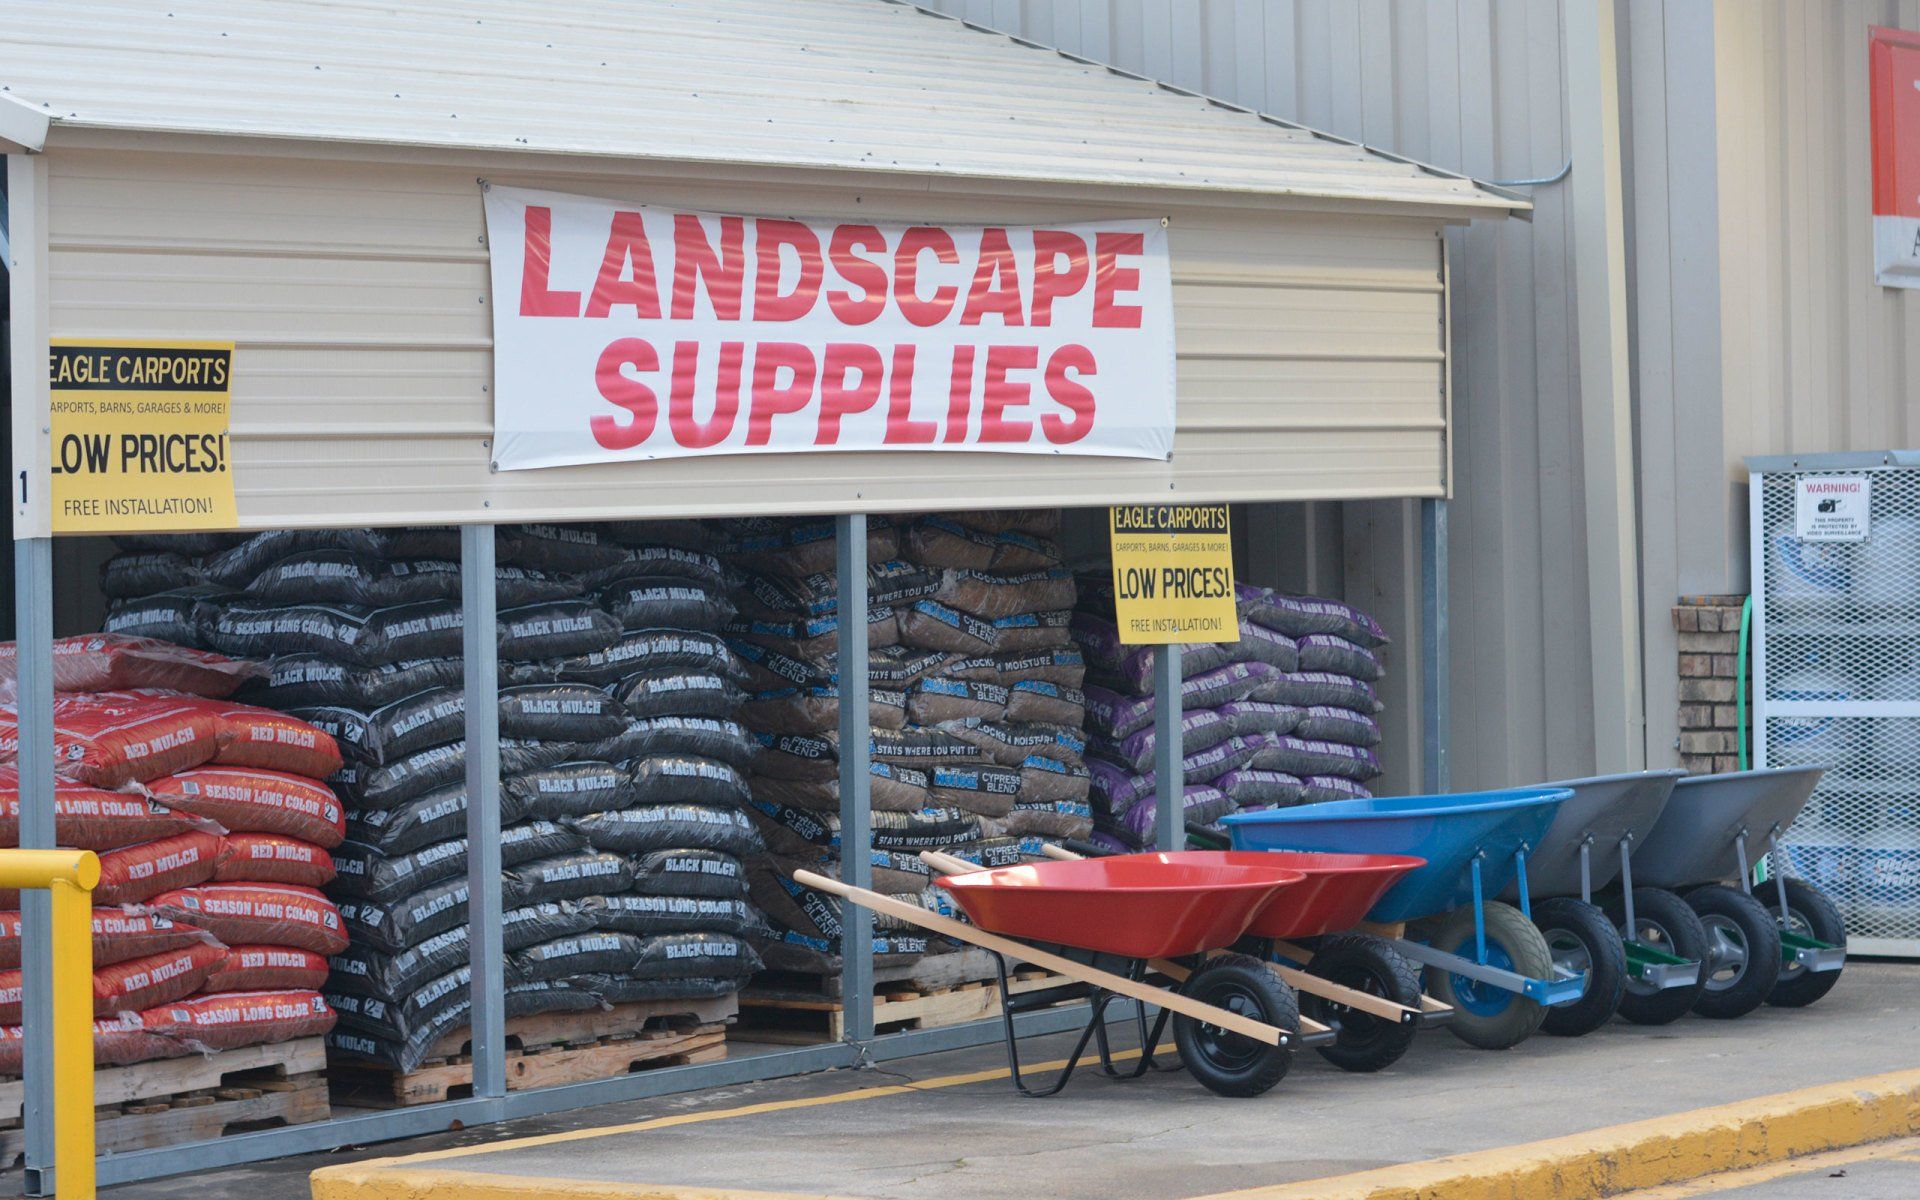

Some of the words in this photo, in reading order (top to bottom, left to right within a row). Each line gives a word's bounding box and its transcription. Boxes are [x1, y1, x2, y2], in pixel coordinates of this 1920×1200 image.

[519, 206, 1145, 329] LANDSCAPE
[116, 356, 226, 384] CARPORTS
[589, 337, 1098, 450] SUPPLIES
[50, 402, 97, 414] ARPORTS,
[100, 402, 135, 414] BARNS,
[137, 402, 181, 414] GARAGES
[184, 403, 191, 413] &
[194, 403, 225, 414] MORE!
[51, 434, 111, 474] OW
[121, 434, 226, 474] PRICES!
[20, 471, 27, 503] 1
[1806, 483, 1860, 493] WARNING!
[64, 500, 100, 516] FREE
[105, 498, 213, 516] INSTALLATION!
[1116, 506, 1155, 528] EAGLE
[1158, 507, 1226, 529] CARPORTS
[560, 530, 597, 545] MULCH
[1116, 543, 1148, 552] CARPORTS,
[1149, 543, 1171, 552] BARNS,
[1172, 543, 1200, 552] GARAGES
[1207, 543, 1229, 552] MORE!
[1118, 568, 1156, 599] LOW
[1163, 567, 1231, 599] PRICES!
[630, 588, 667, 602] BLACK
[669, 587, 705, 601] MULCH
[236, 621, 271, 635] SEASON
[274, 619, 299, 633] LONG
[302, 621, 334, 639] COLOR
[385, 618, 428, 639] BLACK
[429, 613, 463, 631] MULC
[512, 623, 550, 638] BLACK
[553, 616, 592, 635] MULCH
[1131, 619, 1150, 632] FREE
[1153, 617, 1222, 632] INSTALLATION!
[607, 642, 649, 662] SEASON
[651, 640, 680, 653] LONG
[682, 640, 713, 656] COLOR
[768, 660, 806, 684] BLEND
[1005, 656, 1050, 671] MOISTURE
[649, 676, 685, 693] BLACK
[687, 676, 722, 689] MULCH
[970, 682, 1009, 696] CYPRESS
[522, 700, 558, 713] BLACK
[561, 701, 601, 715] MULCH
[977, 692, 1006, 705] BLEND
[392, 711, 433, 737] BLACK
[434, 698, 465, 718] MULC
[652, 717, 681, 729] LONG
[683, 718, 721, 732] COLOR
[251, 726, 274, 742] RED
[277, 729, 315, 748] MULCH
[977, 724, 1006, 742] LOCKS
[124, 740, 148, 760] RED
[152, 727, 195, 753] MULCH
[877, 745, 902, 755] STAYS
[904, 746, 930, 756] WHERE
[933, 746, 948, 755] YOU
[950, 746, 966, 755] PUT
[662, 762, 697, 776] BLACK
[699, 764, 731, 783] MULCH
[982, 773, 1020, 785] CYPRESS
[539, 779, 574, 793] BLACK
[577, 776, 615, 791] MULCH
[987, 782, 1016, 793] BLEND
[66, 801, 98, 816] LONG
[102, 802, 144, 816] COLOR
[206, 784, 250, 801] SEASON
[253, 790, 282, 807] LONG
[285, 793, 319, 814] COLOR
[418, 798, 459, 823] BLACK
[623, 809, 665, 823] SEASON
[668, 810, 697, 822] LONG
[698, 811, 732, 826] COLOR
[879, 837, 903, 846] STAYS
[906, 837, 933, 846] WHERE
[935, 836, 951, 845] YOU
[954, 833, 968, 842] PUT
[251, 844, 274, 859] RED
[276, 846, 312, 862] MULCH
[985, 845, 1020, 857] CYPRESS
[990, 855, 1019, 866] BLEND
[129, 861, 153, 880] RED
[156, 847, 199, 873] MULCH
[543, 865, 578, 882] BLACK
[581, 860, 619, 879] MULCH
[666, 858, 699, 872] BLACK
[701, 861, 736, 877] MULCH
[204, 899, 250, 915] SEASON
[254, 901, 283, 918] LONG
[285, 905, 319, 924] COLOR
[412, 894, 452, 923] BLACK
[624, 897, 666, 911] SEASON
[668, 898, 697, 913] LONG
[699, 899, 731, 913] COLOR
[105, 918, 147, 933] COLOR
[420, 927, 466, 957] SEASON
[541, 942, 579, 959] BLACK
[581, 937, 621, 952] MULCH
[666, 944, 701, 959] BLACK
[703, 943, 737, 956] MULCH
[242, 953, 264, 968] RED
[268, 952, 306, 968] MULCH
[124, 972, 149, 992] RED
[152, 956, 192, 984] MULCH
[415, 978, 457, 1008] BLACK
[196, 1009, 239, 1025] SEASON
[242, 1006, 273, 1022] LONG
[275, 1004, 309, 1018] COLOR
[336, 1034, 375, 1053] MULCH
